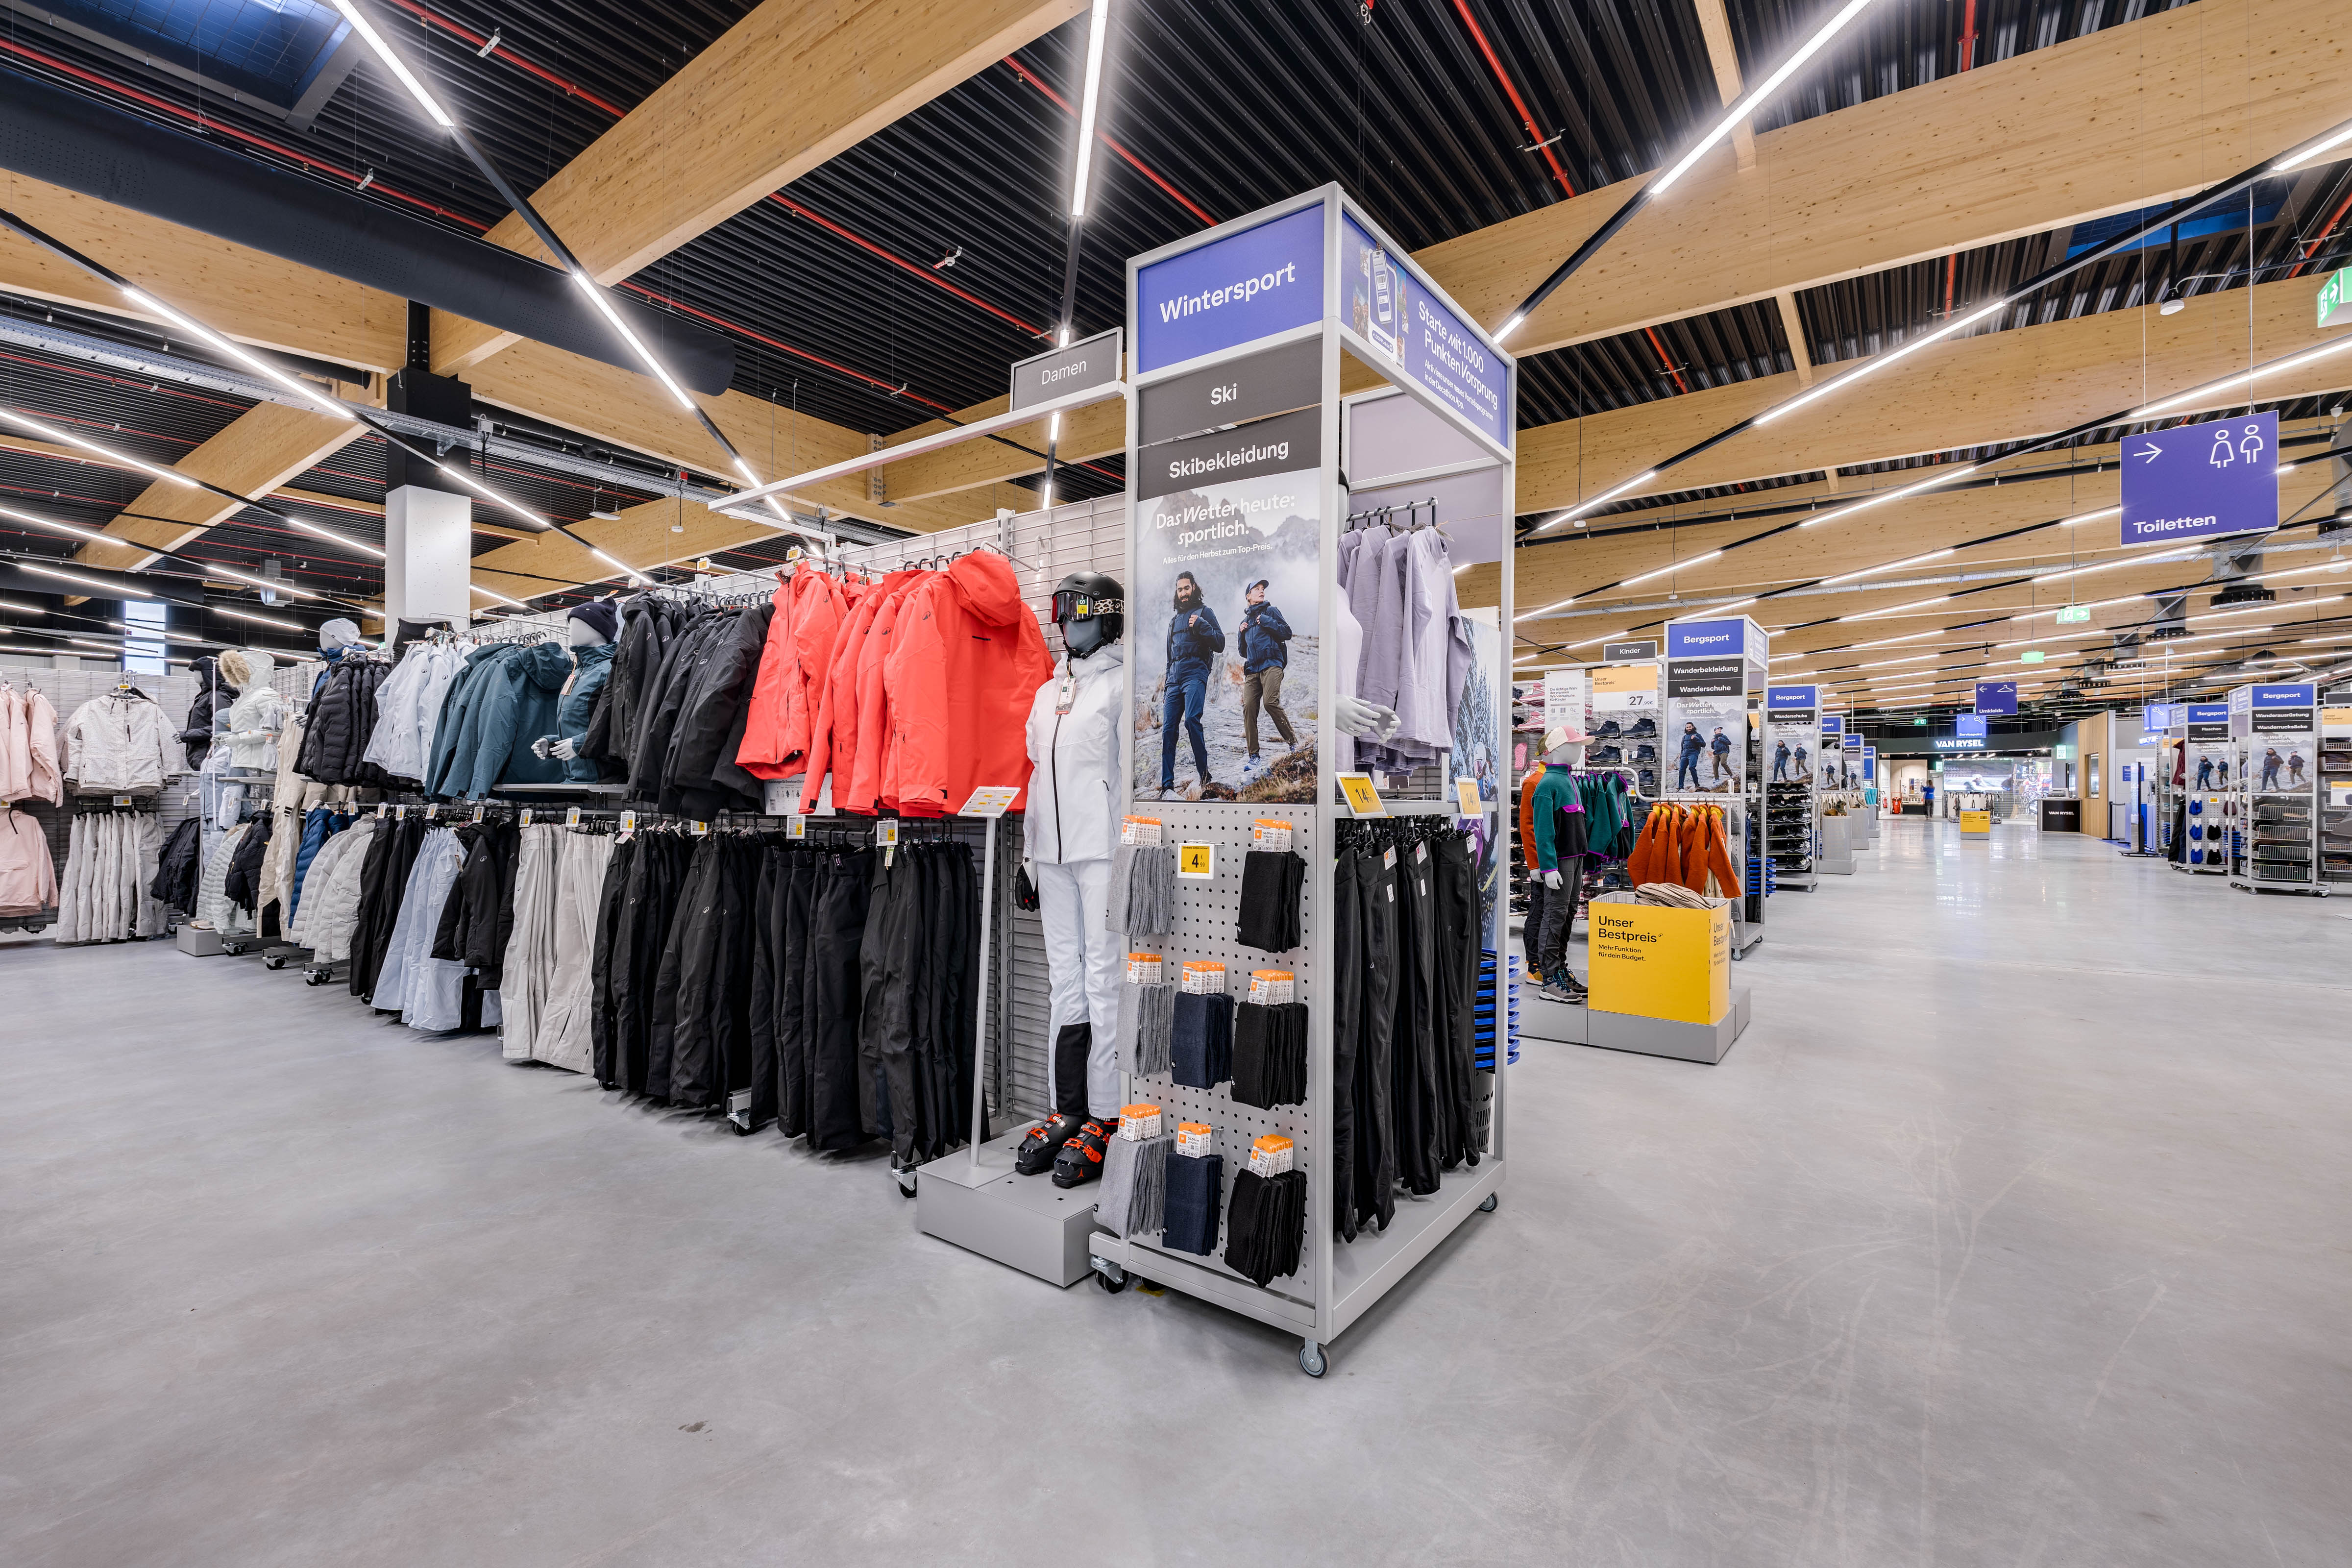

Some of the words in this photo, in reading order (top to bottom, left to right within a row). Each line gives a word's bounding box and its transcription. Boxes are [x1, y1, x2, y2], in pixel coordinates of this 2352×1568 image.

[1160, 261, 1296, 323] Wintersport
[1419, 300, 1447, 340] Starte
[1462, 341, 1484, 373] 1.000
[1042, 360, 1086, 385] Damen
[1425, 329, 1460, 376] Punkten
[1461, 361, 1497, 410] Vorsprung
[1210, 383, 1237, 405] Ski
[1424, 371, 1428, 382] in
[1436, 380, 1455, 402] Decathlon
[1455, 396, 1464, 410] App.
[1425, 359, 1443, 380] Aktiviere
[1443, 375, 1453, 389] unser
[1453, 384, 1464, 397] neues
[1465, 391, 1494, 421] Vorteilsprogramm
[1169, 441, 1289, 478] Skibekleidung
[1156, 513, 1181, 530] Das
[1184, 504, 1238, 524] Wetter
[1240, 494, 1295, 514] heute:
[1177, 519, 1249, 547] sportlich.
[2133, 515, 2216, 534] Toiletten
[1163, 555, 1177, 565] Alles
[1177, 554, 1187, 563] für
[1187, 552, 1199, 561] den
[1200, 549, 1222, 559] Herbst
[1222, 548, 1237, 556] zum
[1238, 542, 1273, 554] Top-Preis.
[1684, 634, 1729, 644] Bergsport
[1673, 665, 1739, 674] Wanderbekleidung
[1355, 788, 1369, 803] 14
[1191, 854, 1199, 868] 4
[1598, 916, 1634, 928] Unser
[1714, 922, 1724, 933] Unser
[1598, 928, 1657, 943] Bestpreis
